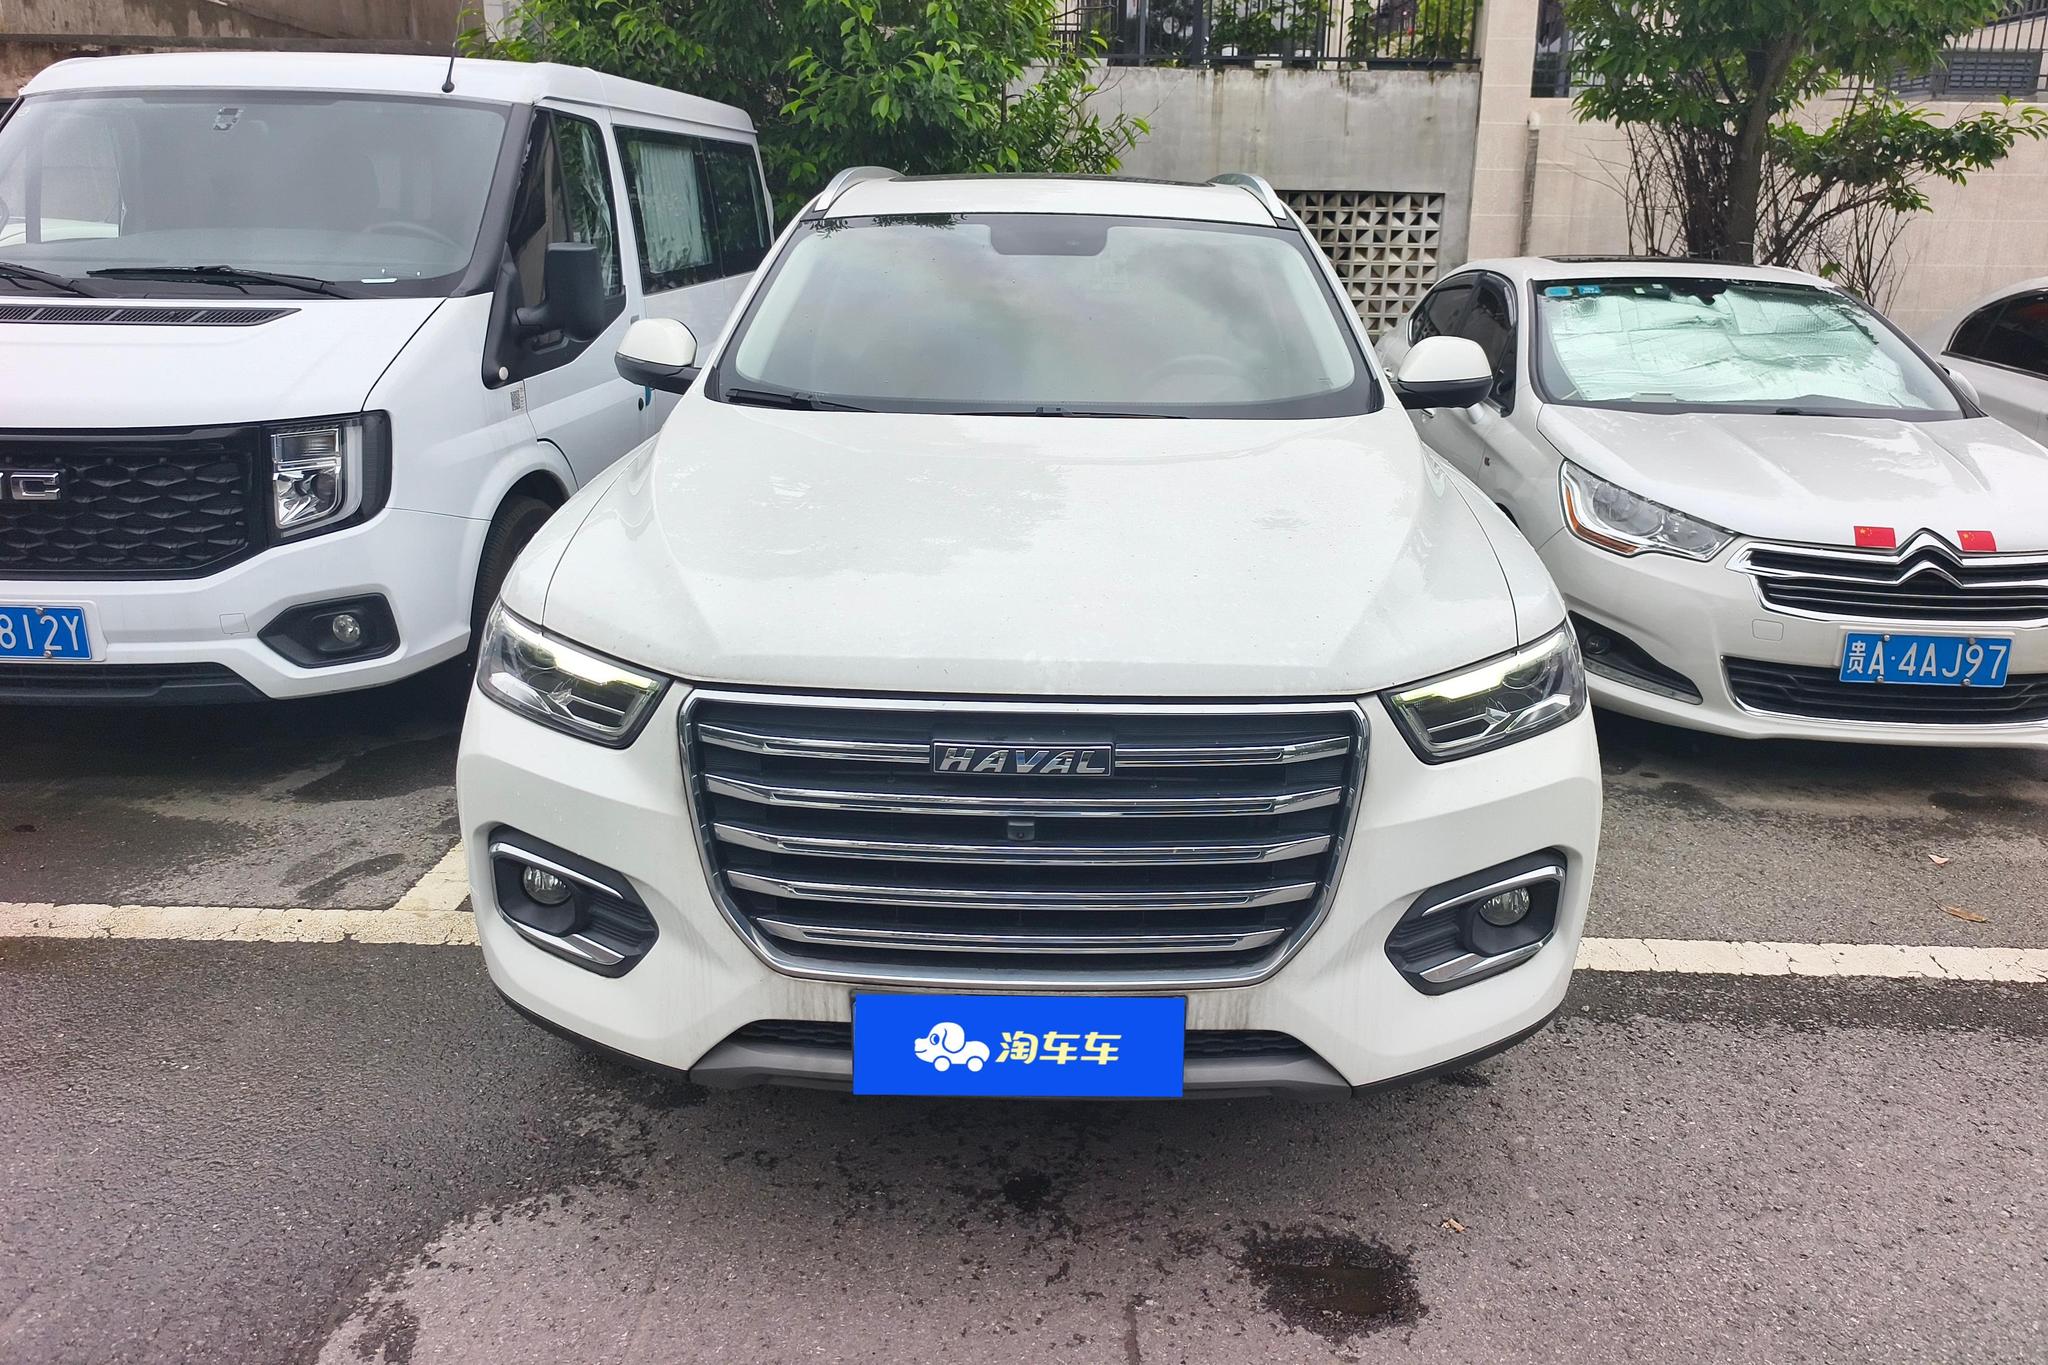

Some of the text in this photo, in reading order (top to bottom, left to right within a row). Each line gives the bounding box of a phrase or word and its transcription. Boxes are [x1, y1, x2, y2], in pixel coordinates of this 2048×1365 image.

[0, 472, 60, 500] C
[0, 614, 79, 651] 812Y
[939, 747, 1106, 774] HAVAL
